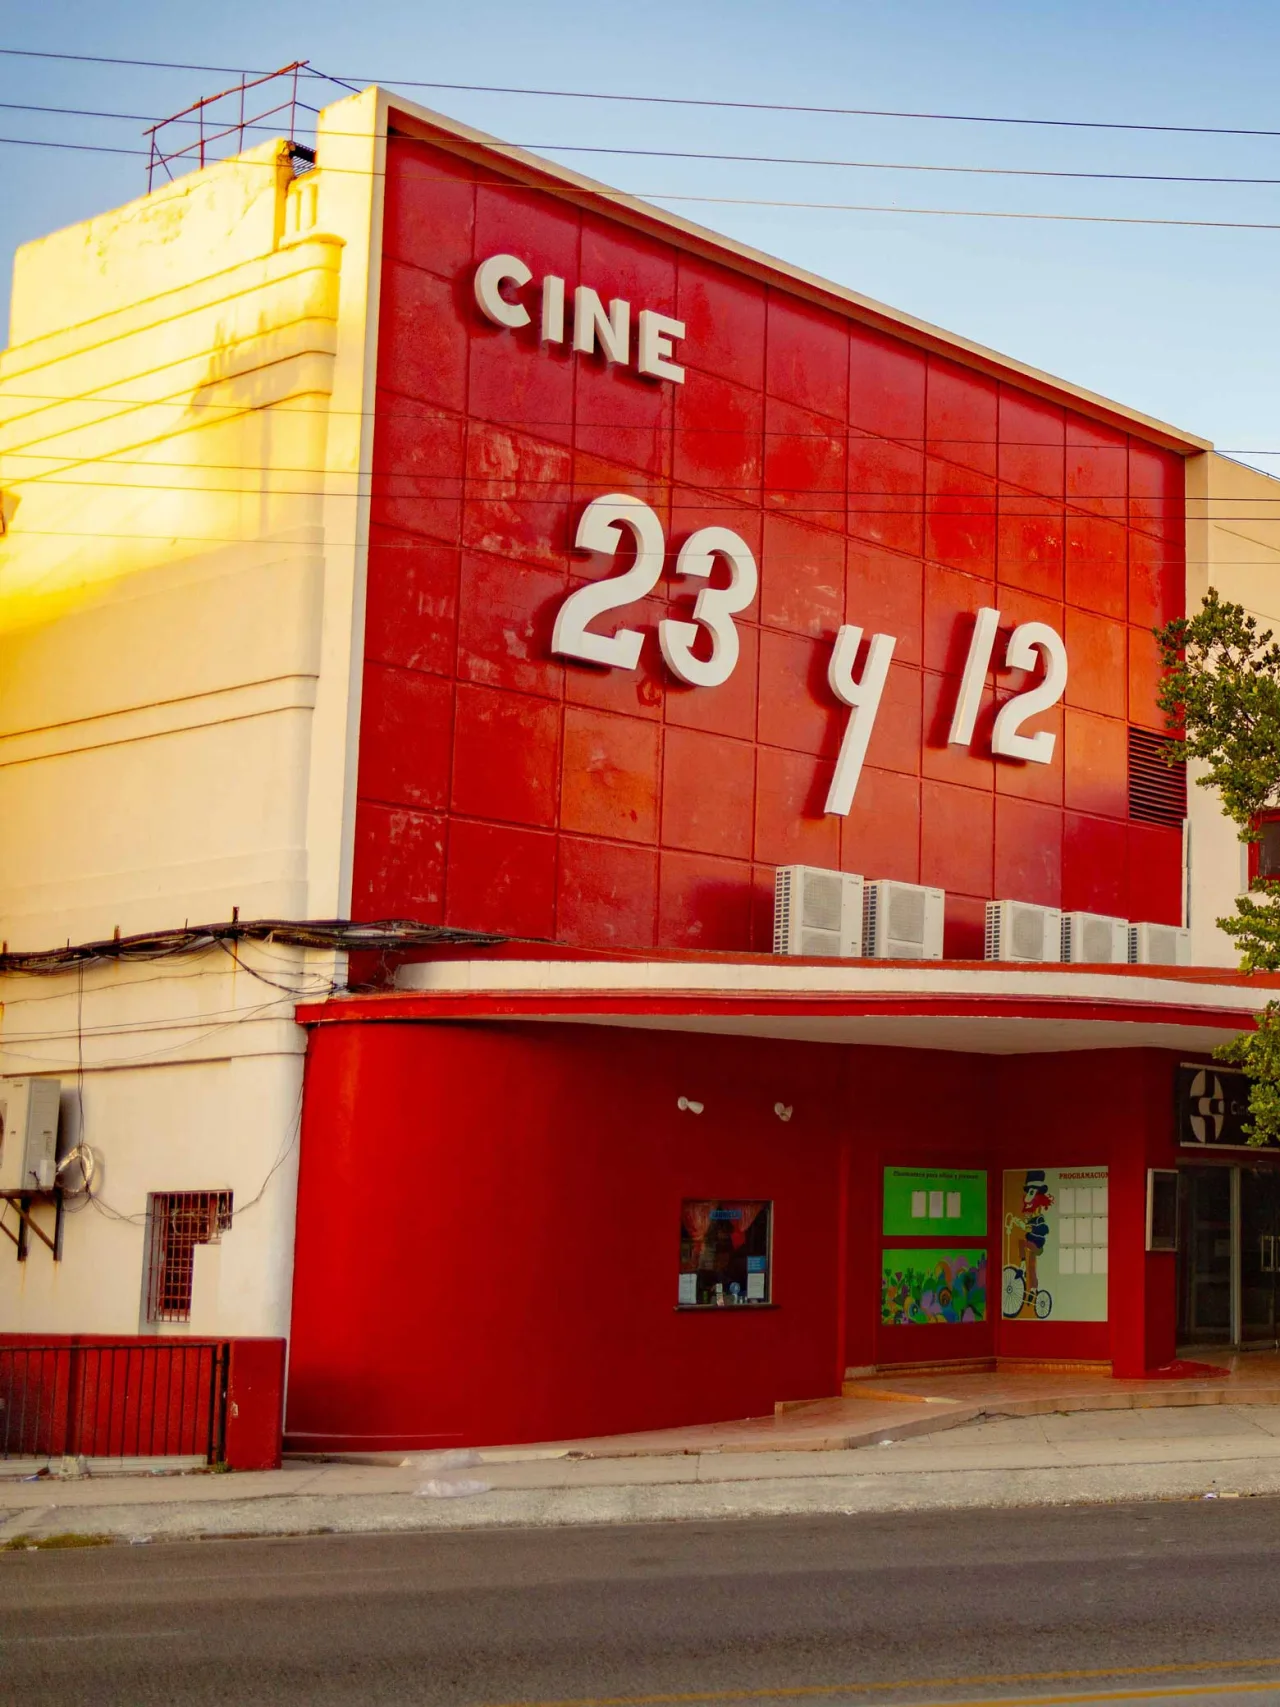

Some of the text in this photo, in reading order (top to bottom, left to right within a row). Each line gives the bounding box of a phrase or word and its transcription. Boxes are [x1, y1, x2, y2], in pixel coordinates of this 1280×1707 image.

[474, 253, 686, 384] CINE
[551, 494, 758, 687] 23
[947, 607, 1068, 764] 12
